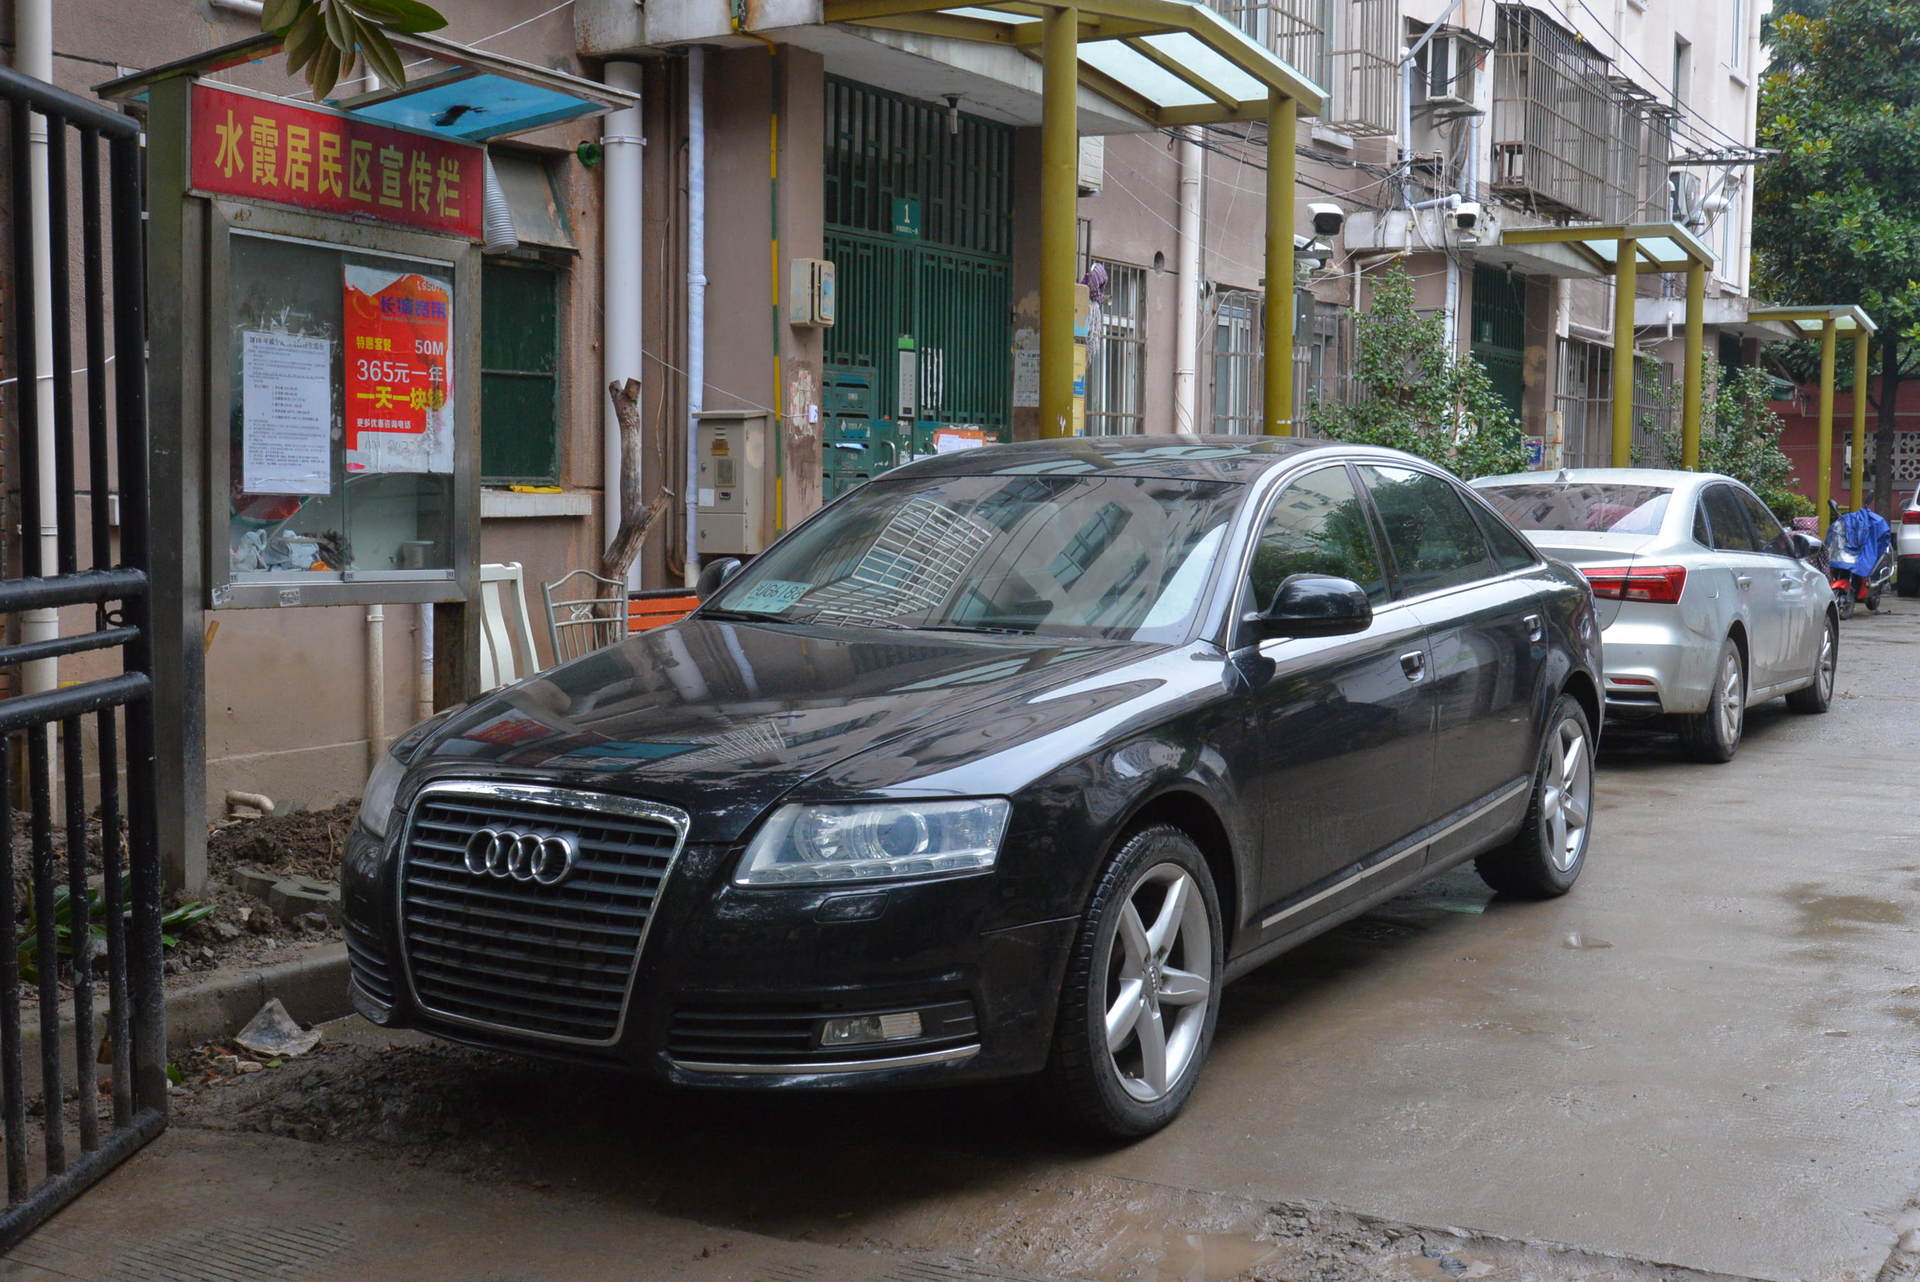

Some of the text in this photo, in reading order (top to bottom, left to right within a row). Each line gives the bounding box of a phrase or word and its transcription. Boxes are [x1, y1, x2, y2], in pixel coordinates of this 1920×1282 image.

[214, 109, 461, 218] 水霞居民区宣传栏
[904, 203, 911, 224] 1
[415, 338, 444, 356] 50M
[356, 359, 443, 383] 365元一年
